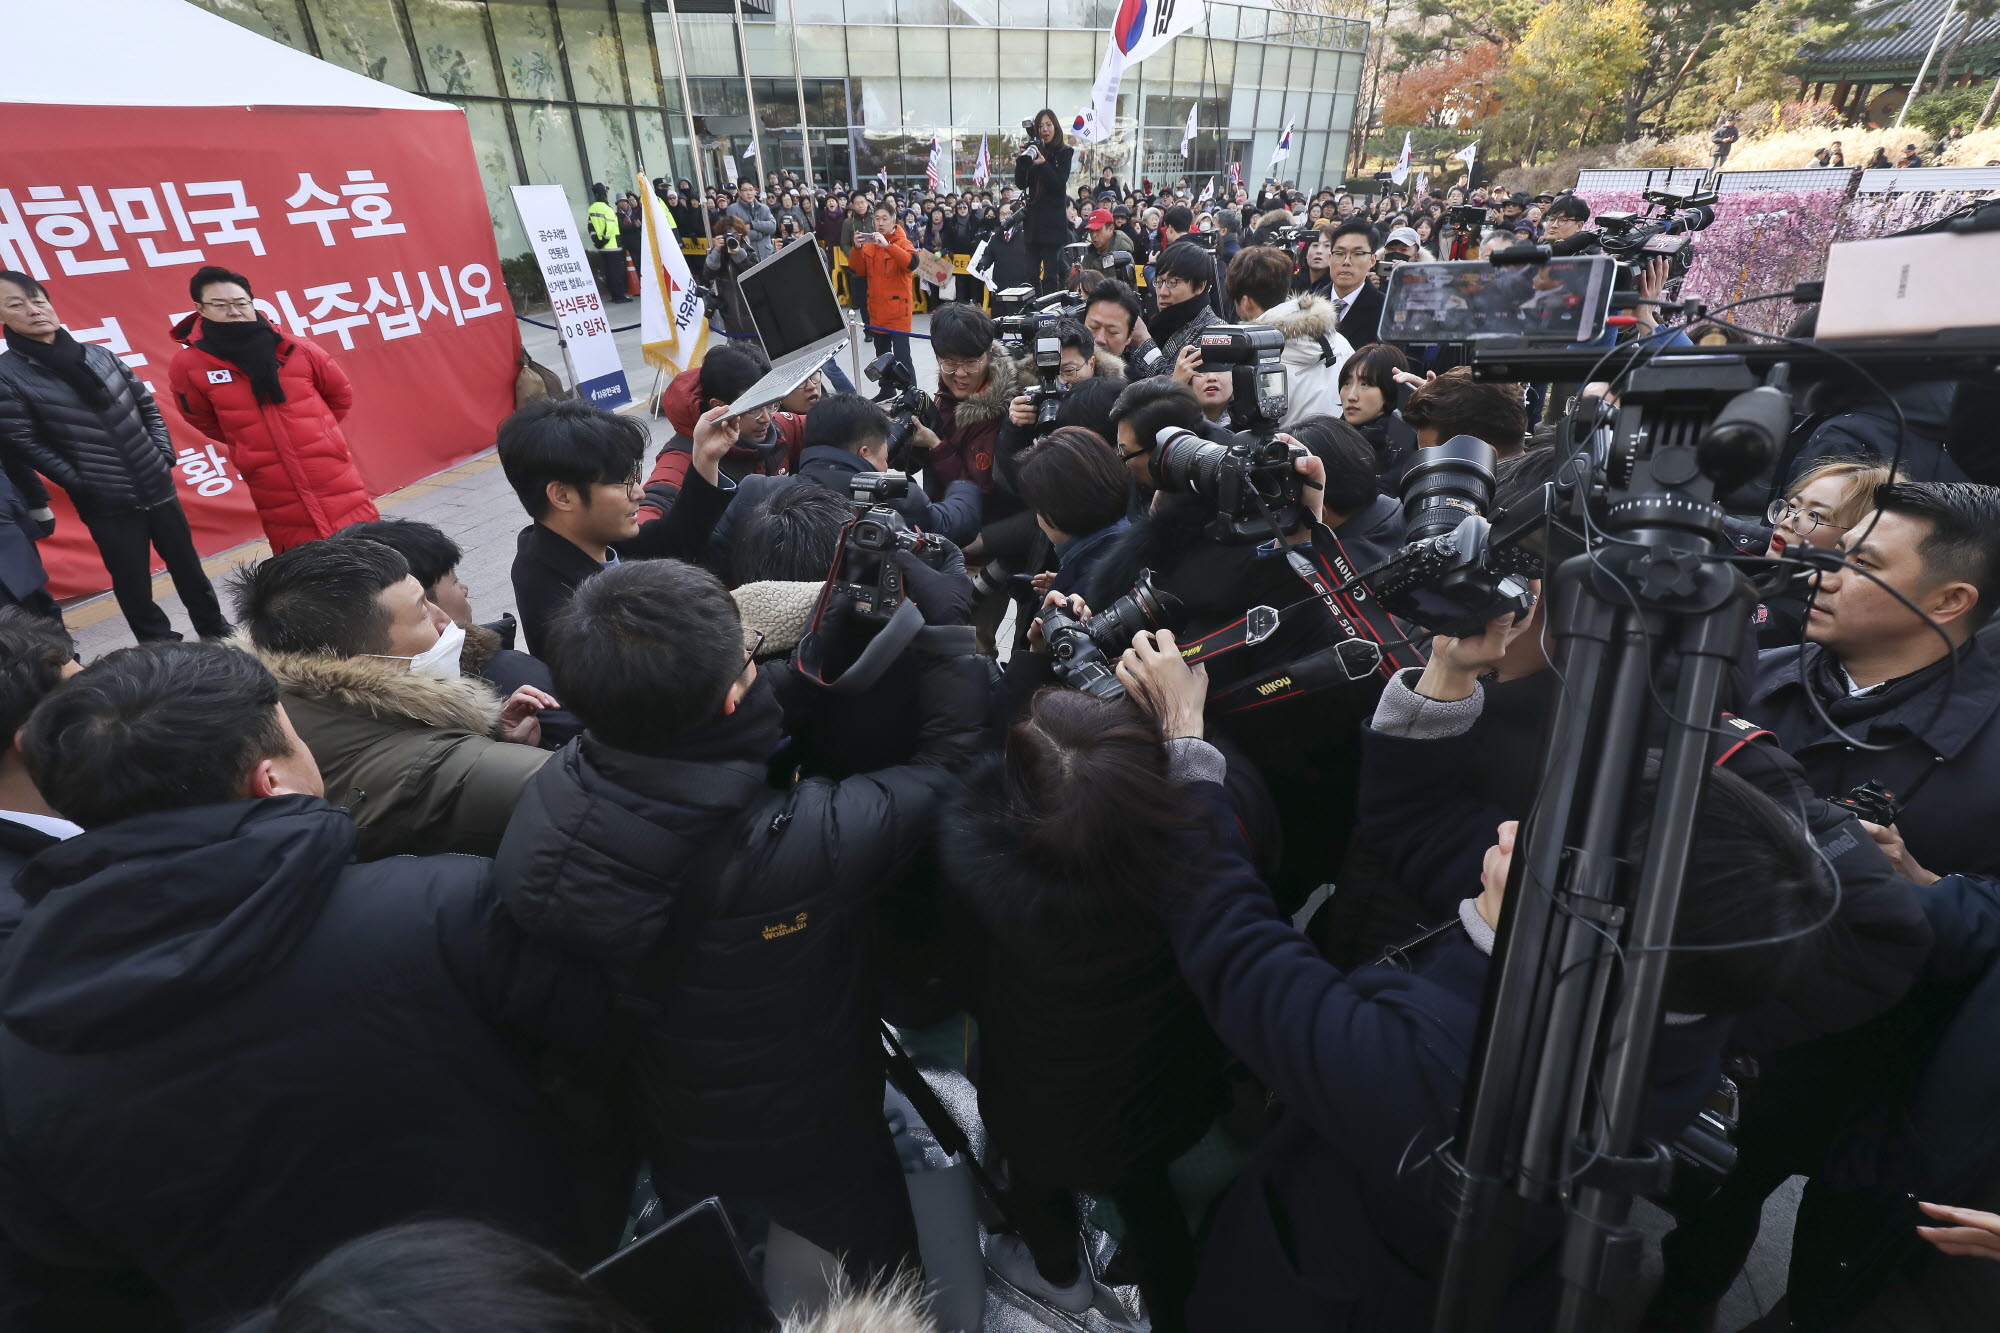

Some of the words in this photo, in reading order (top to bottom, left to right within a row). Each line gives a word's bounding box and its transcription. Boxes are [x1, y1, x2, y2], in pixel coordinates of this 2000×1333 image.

[285, 169, 407, 247] 수호
[538, 228, 567, 242] 공수처법
[548, 246, 570, 260] 연동형
[554, 293, 600, 317] 단식투쟁
[1200, 337, 1232, 345] NEWSIS
[1334, 556, 1367, 602] Cnon
[1180, 644, 1203, 657] Niko
